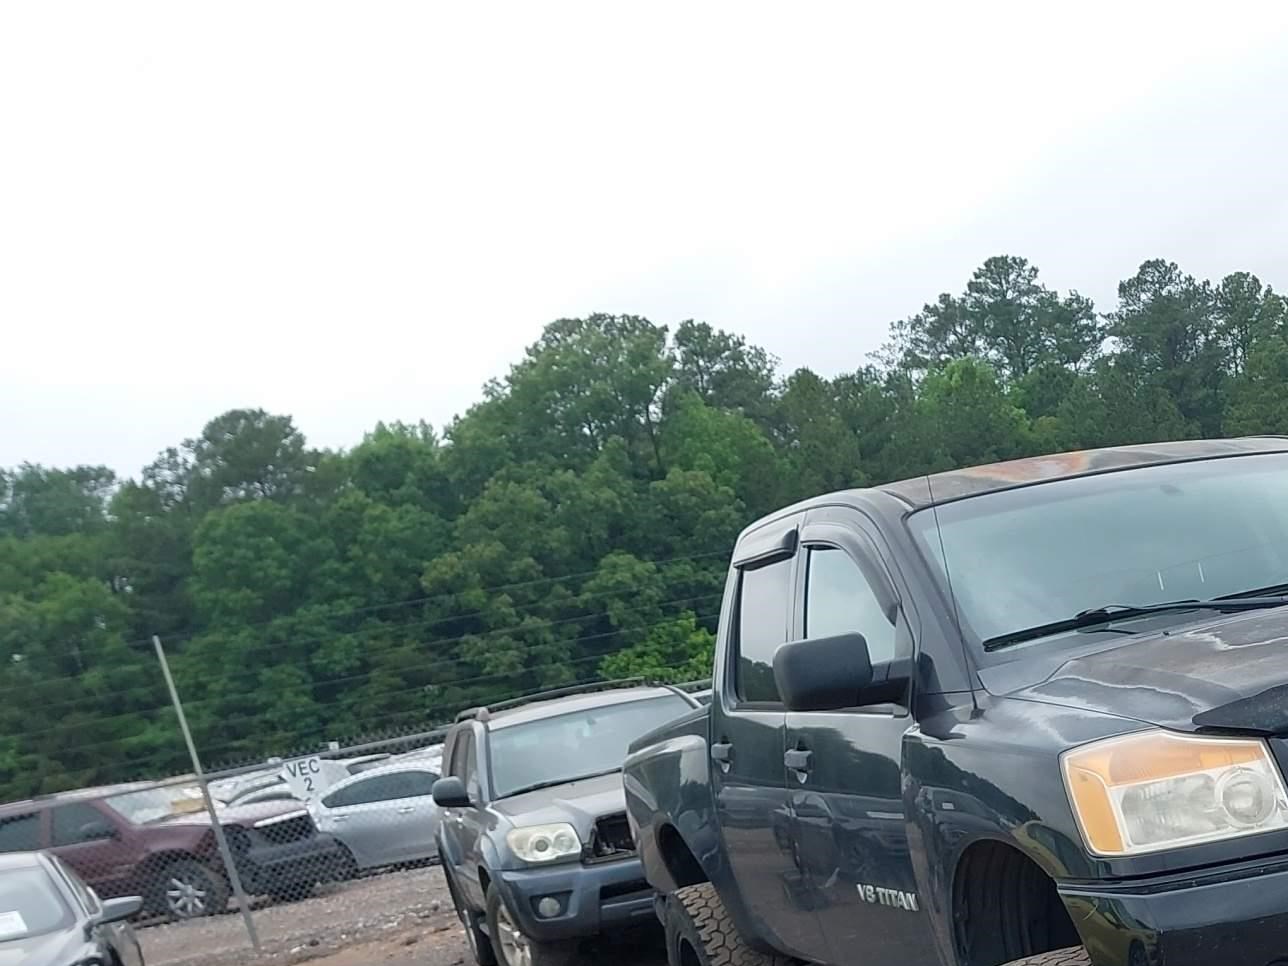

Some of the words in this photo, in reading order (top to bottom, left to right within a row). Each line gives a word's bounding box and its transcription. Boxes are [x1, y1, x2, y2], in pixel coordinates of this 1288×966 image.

[286, 759, 320, 778] VEC
[303, 777, 315, 791] 2
[856, 883, 875, 904] V8
[875, 886, 920, 912] TITAN
